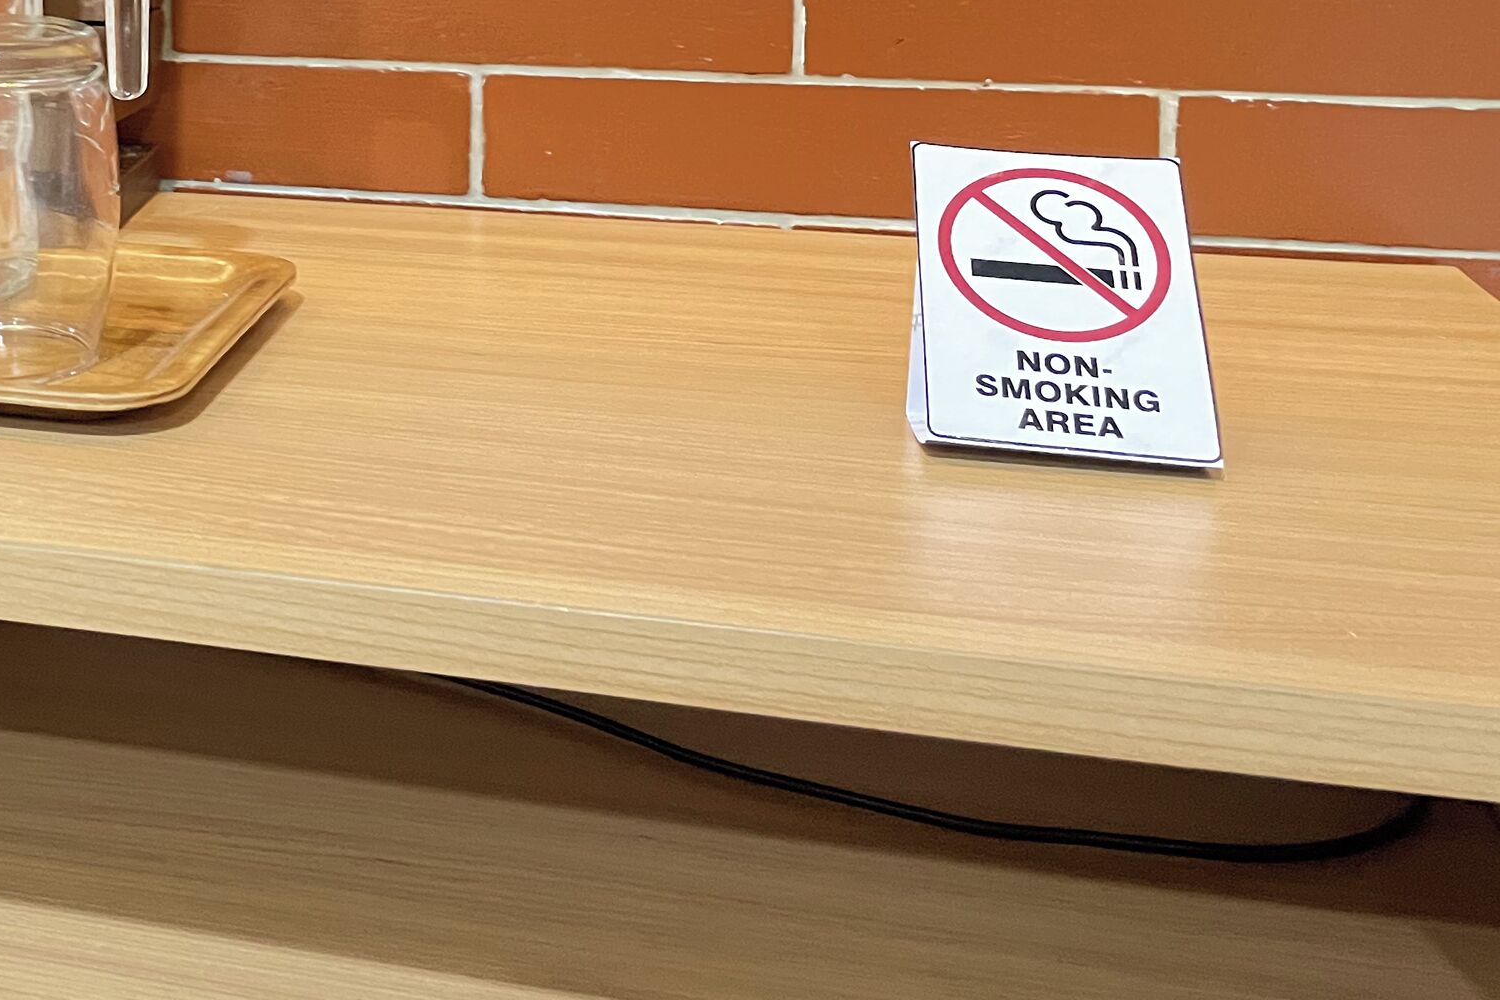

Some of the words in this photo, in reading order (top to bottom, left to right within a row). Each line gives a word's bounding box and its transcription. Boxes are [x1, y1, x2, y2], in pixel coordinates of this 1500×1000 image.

[1016, 350, 1113, 378] NON-
[975, 374, 1161, 413] SMOKING
[1018, 408, 1124, 439] AREA
